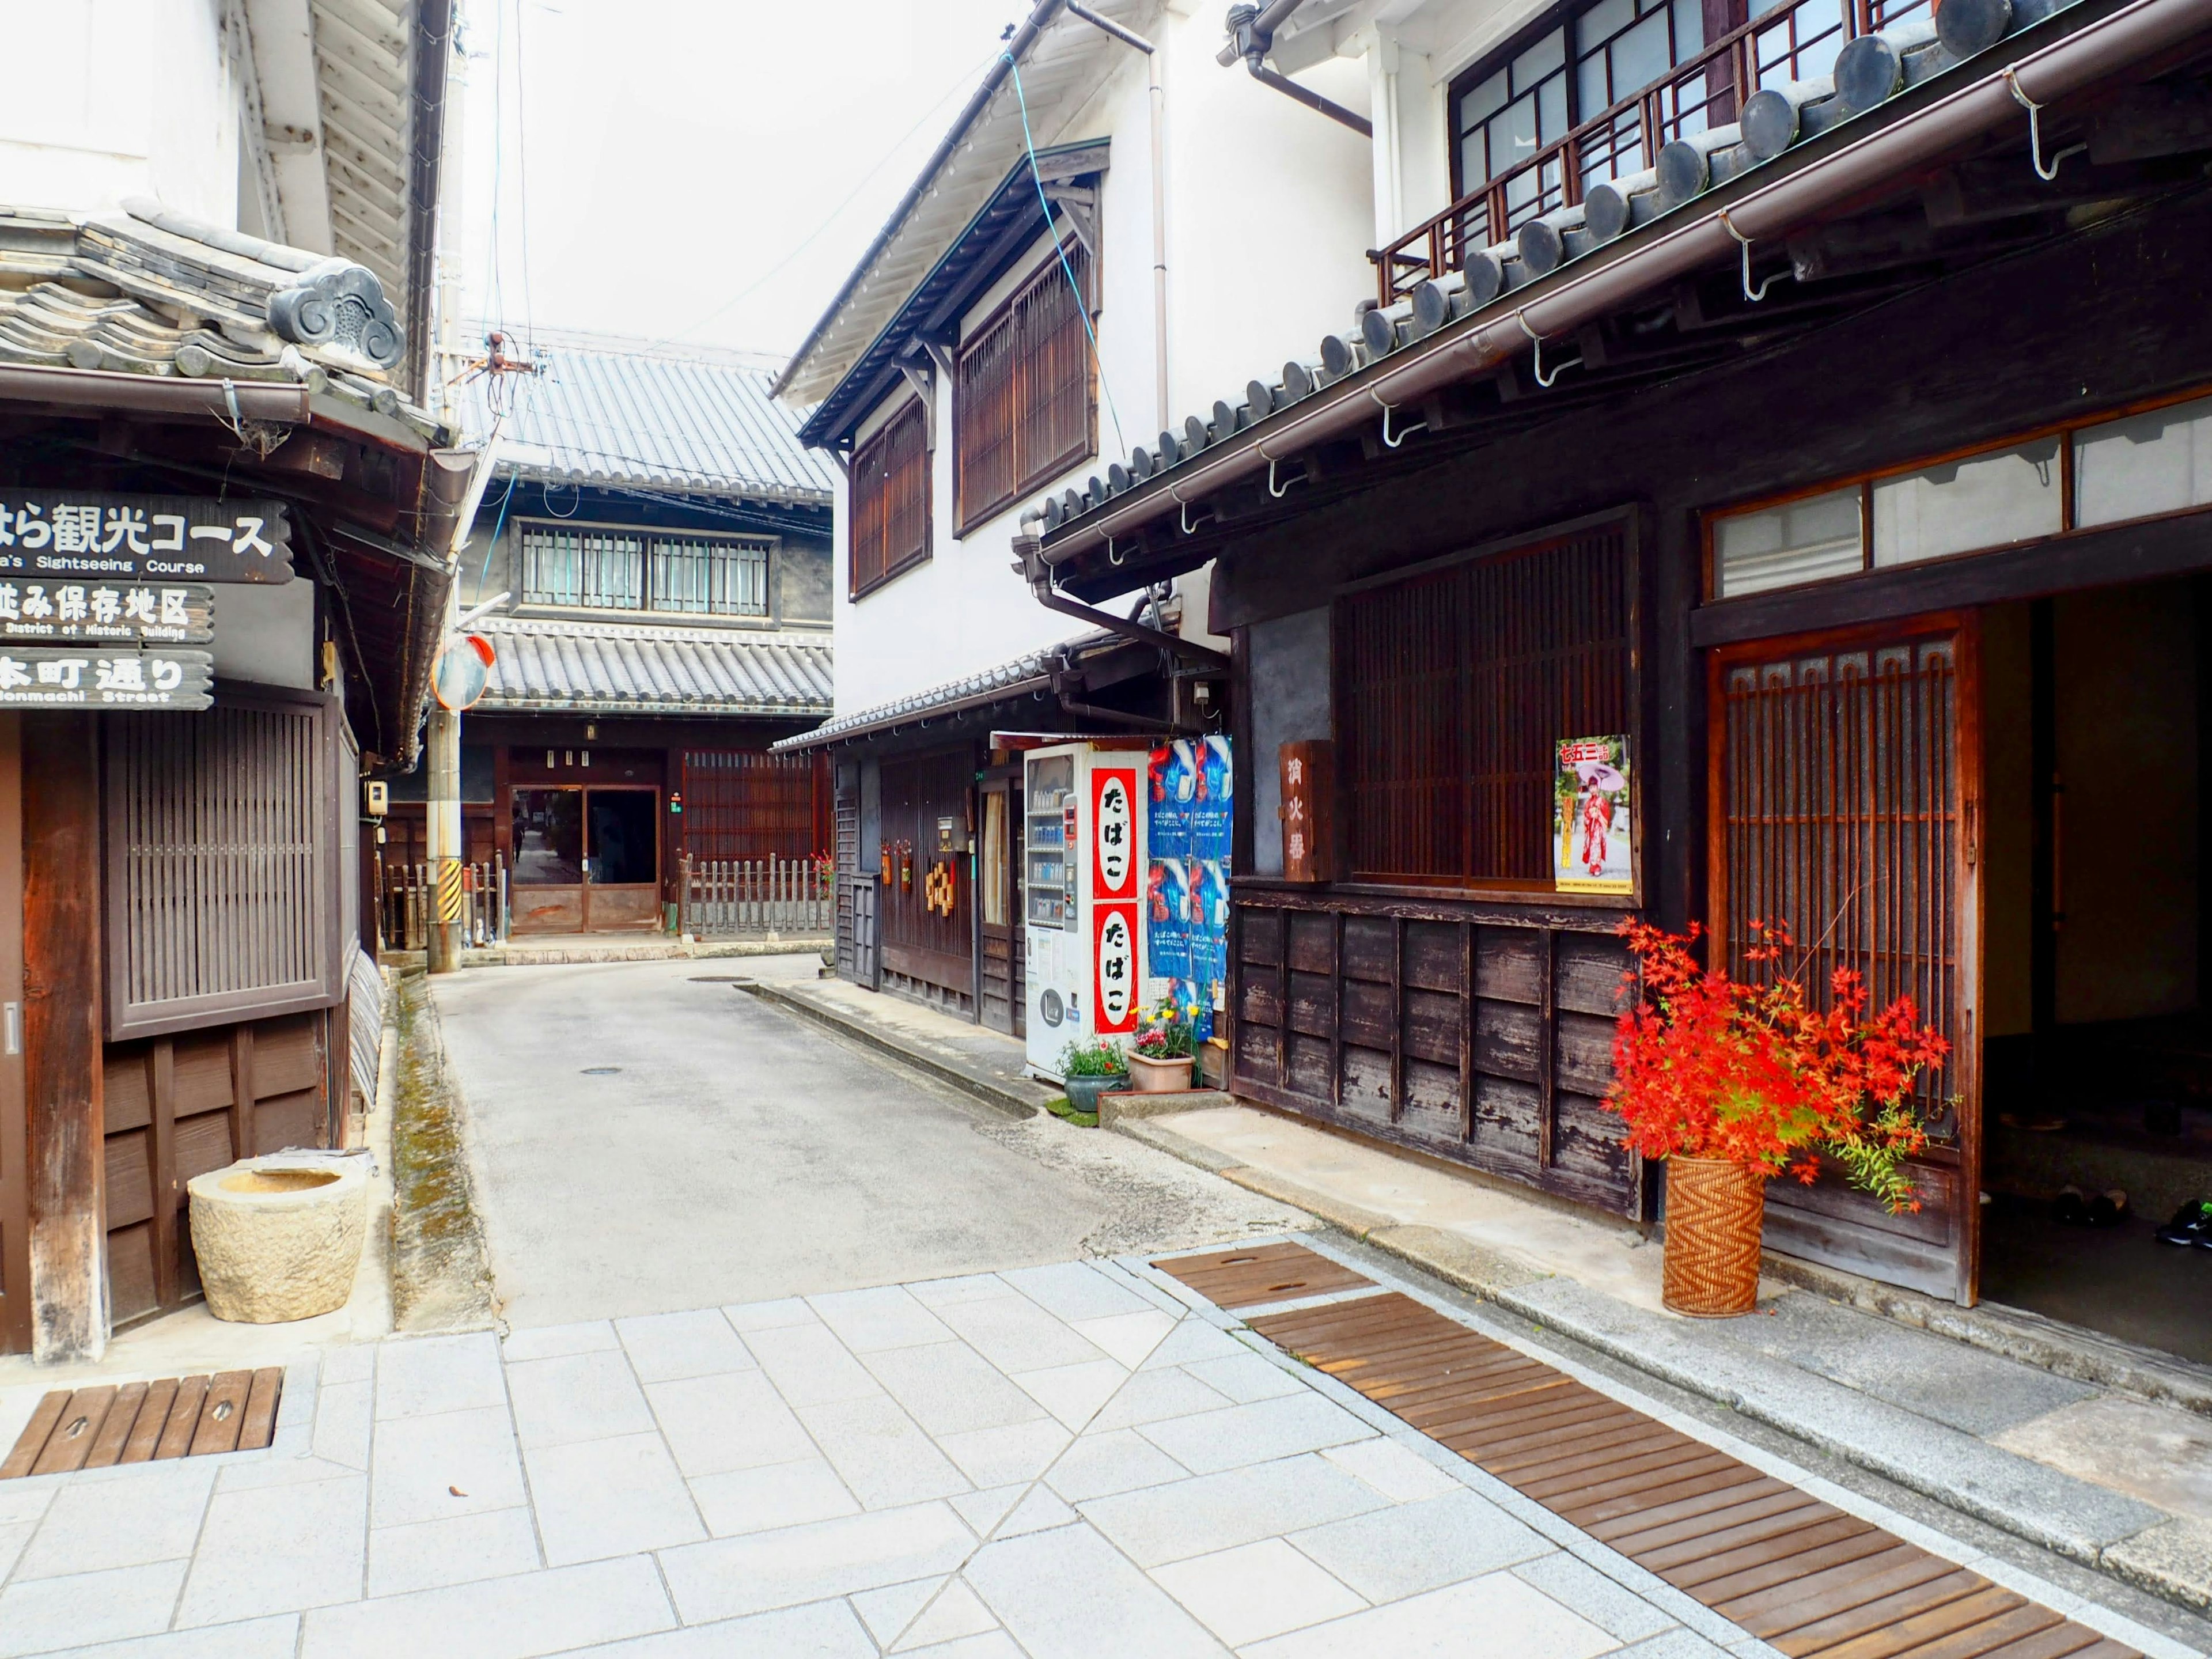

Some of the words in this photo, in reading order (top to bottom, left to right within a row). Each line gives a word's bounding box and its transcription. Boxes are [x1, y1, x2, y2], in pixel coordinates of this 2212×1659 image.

[36, 555, 133, 573] Sightseeing
[146, 559, 205, 574] Course
[6, 622, 54, 634] District
[62, 623, 78, 635] of
[85, 623, 132, 637] Historic
[0, 656, 182, 691] 本町通り
[101, 691, 171, 703] Street
[1287, 757, 1305, 859] 消火器
[1104, 788, 1128, 877] たばこ
[1105, 923, 1130, 1012] たばこ
